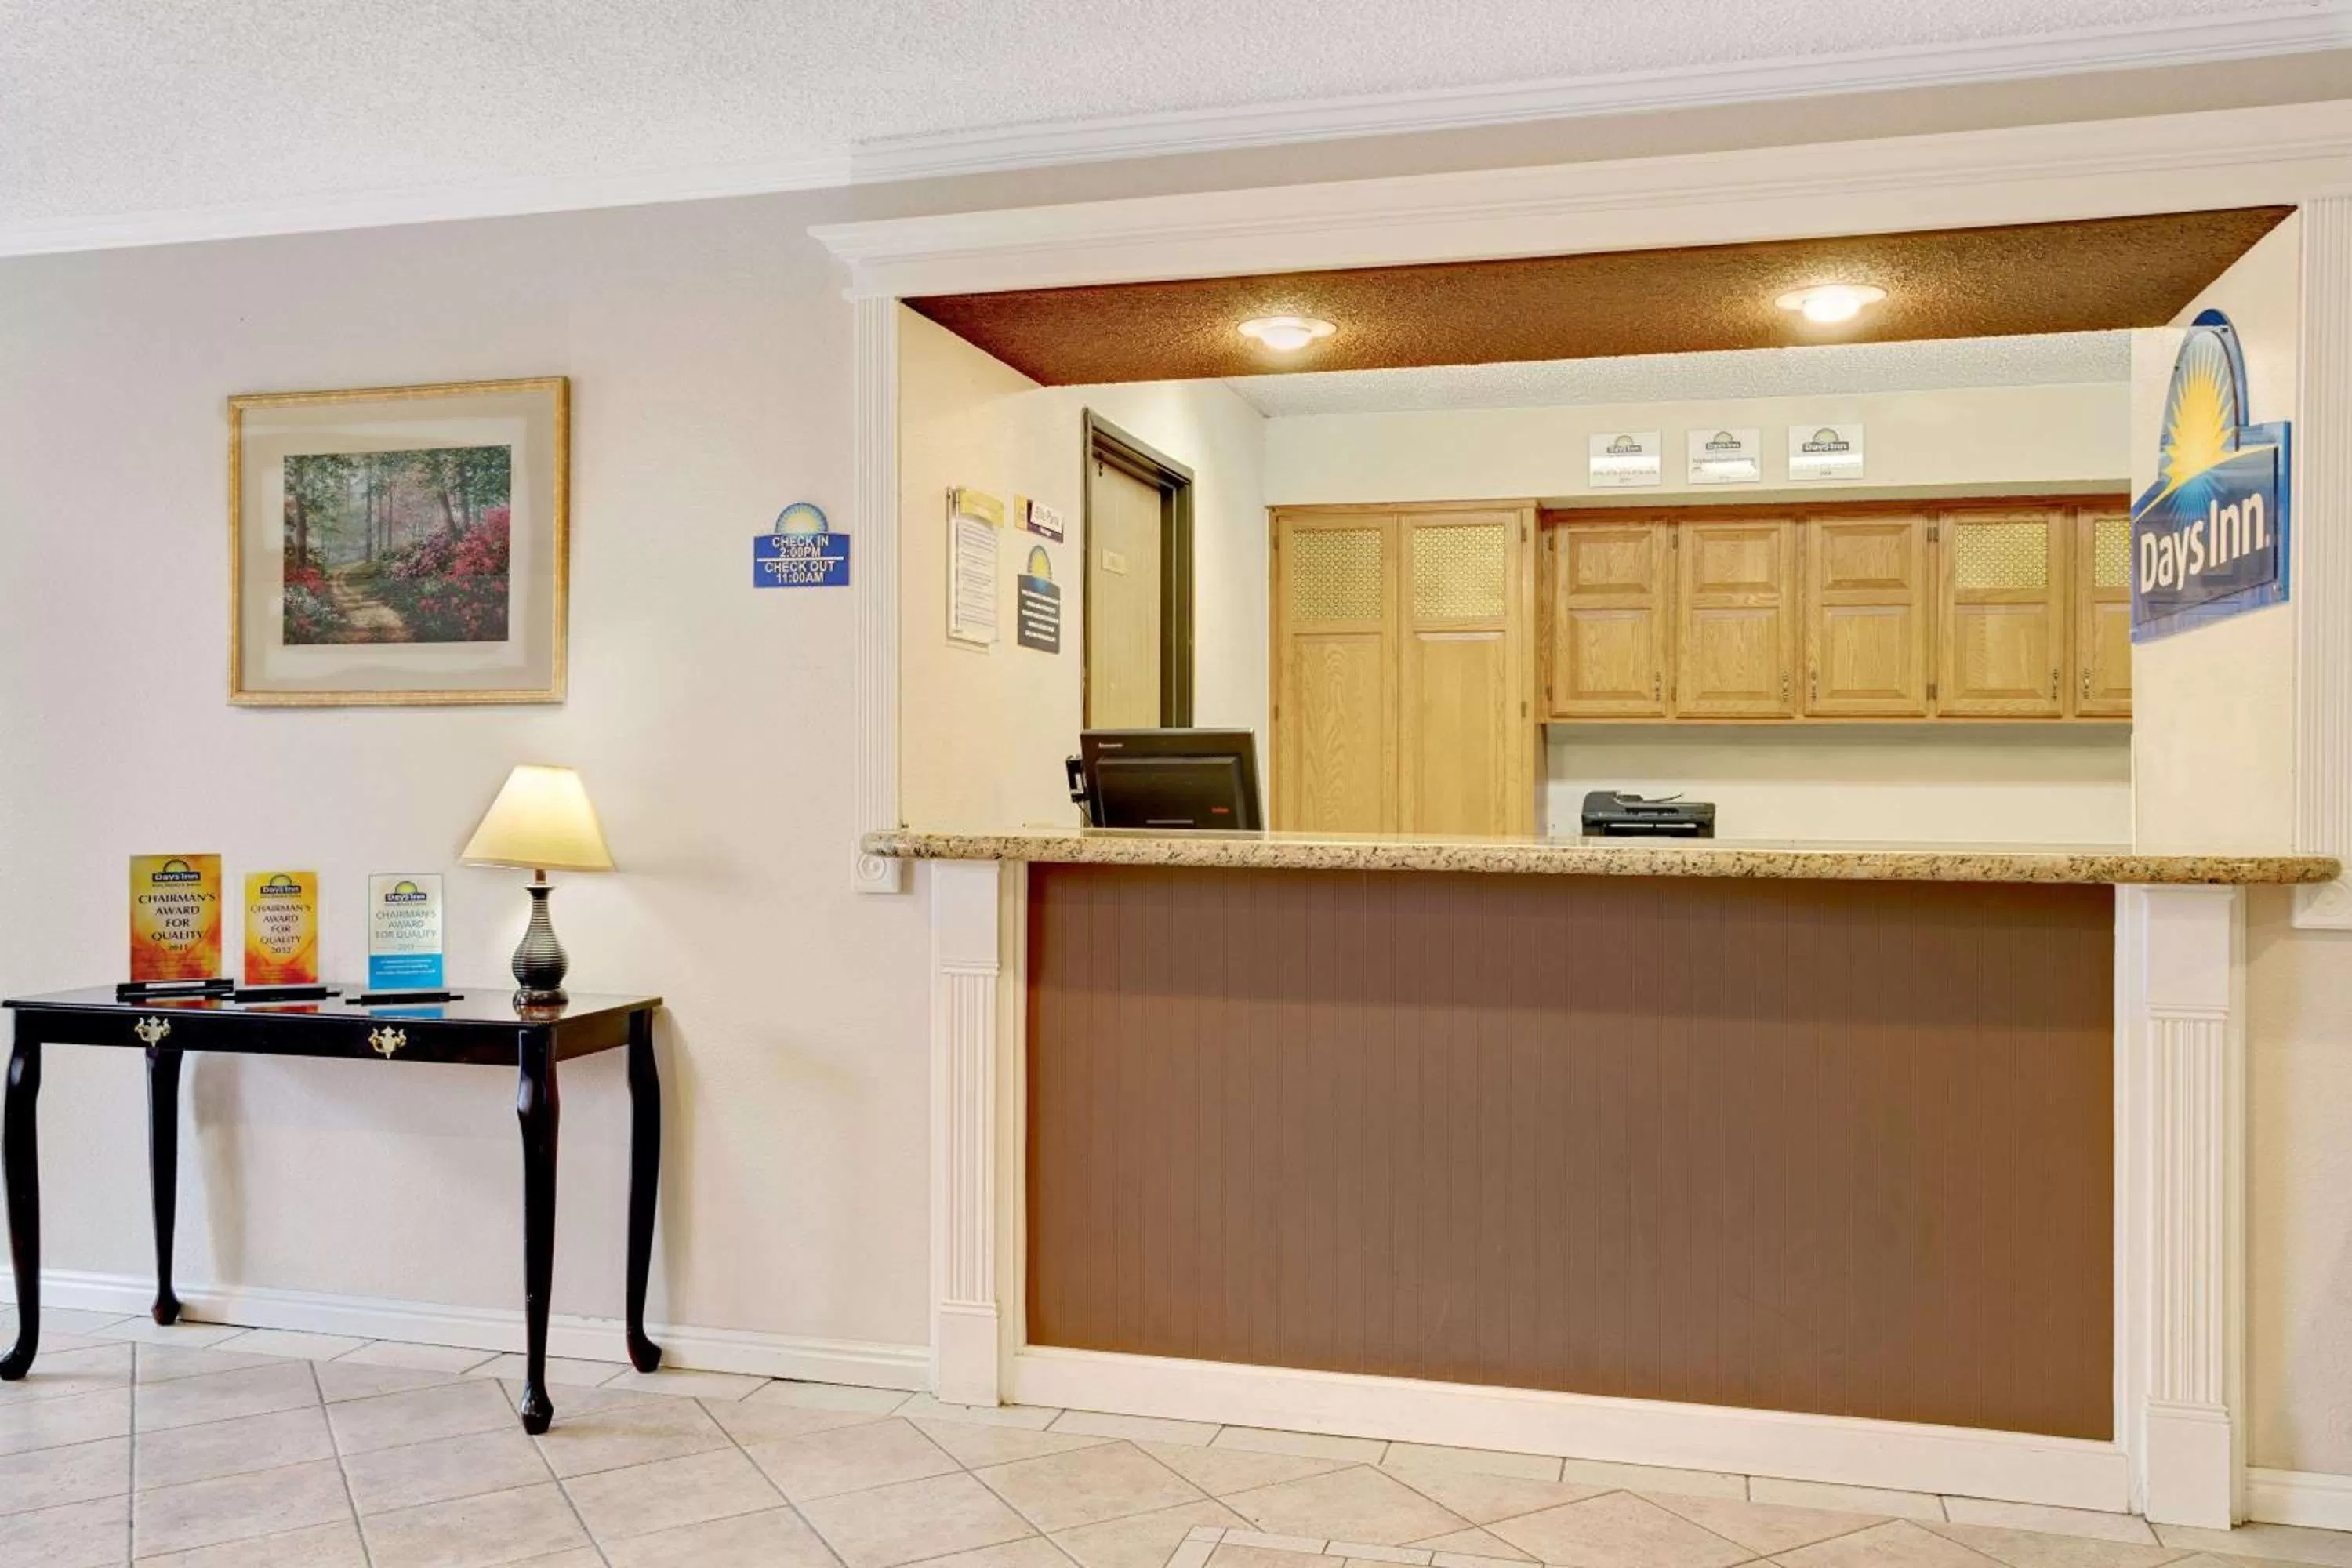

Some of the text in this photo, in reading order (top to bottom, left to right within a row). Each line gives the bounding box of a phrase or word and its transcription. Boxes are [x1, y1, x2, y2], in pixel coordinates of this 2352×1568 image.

[772, 535, 829, 547] CHECK IN
[779, 546, 821, 557] 2:00PM
[2140, 520, 2205, 595] Days
[764, 561, 835, 573] CHECK OUT
[776, 572, 824, 583] 11:00AM
[138, 893, 216, 904] CHAIRMAN'S
[155, 906, 200, 915] AWARD
[250, 904, 312, 913] CHAIRMAN'S
[165, 918, 190, 927] FOR
[388, 920, 424, 929] AWARD
[151, 931, 203, 941] QUALITY
[260, 935, 302, 944] QUALITY
[396, 930, 437, 939] QUALITY
